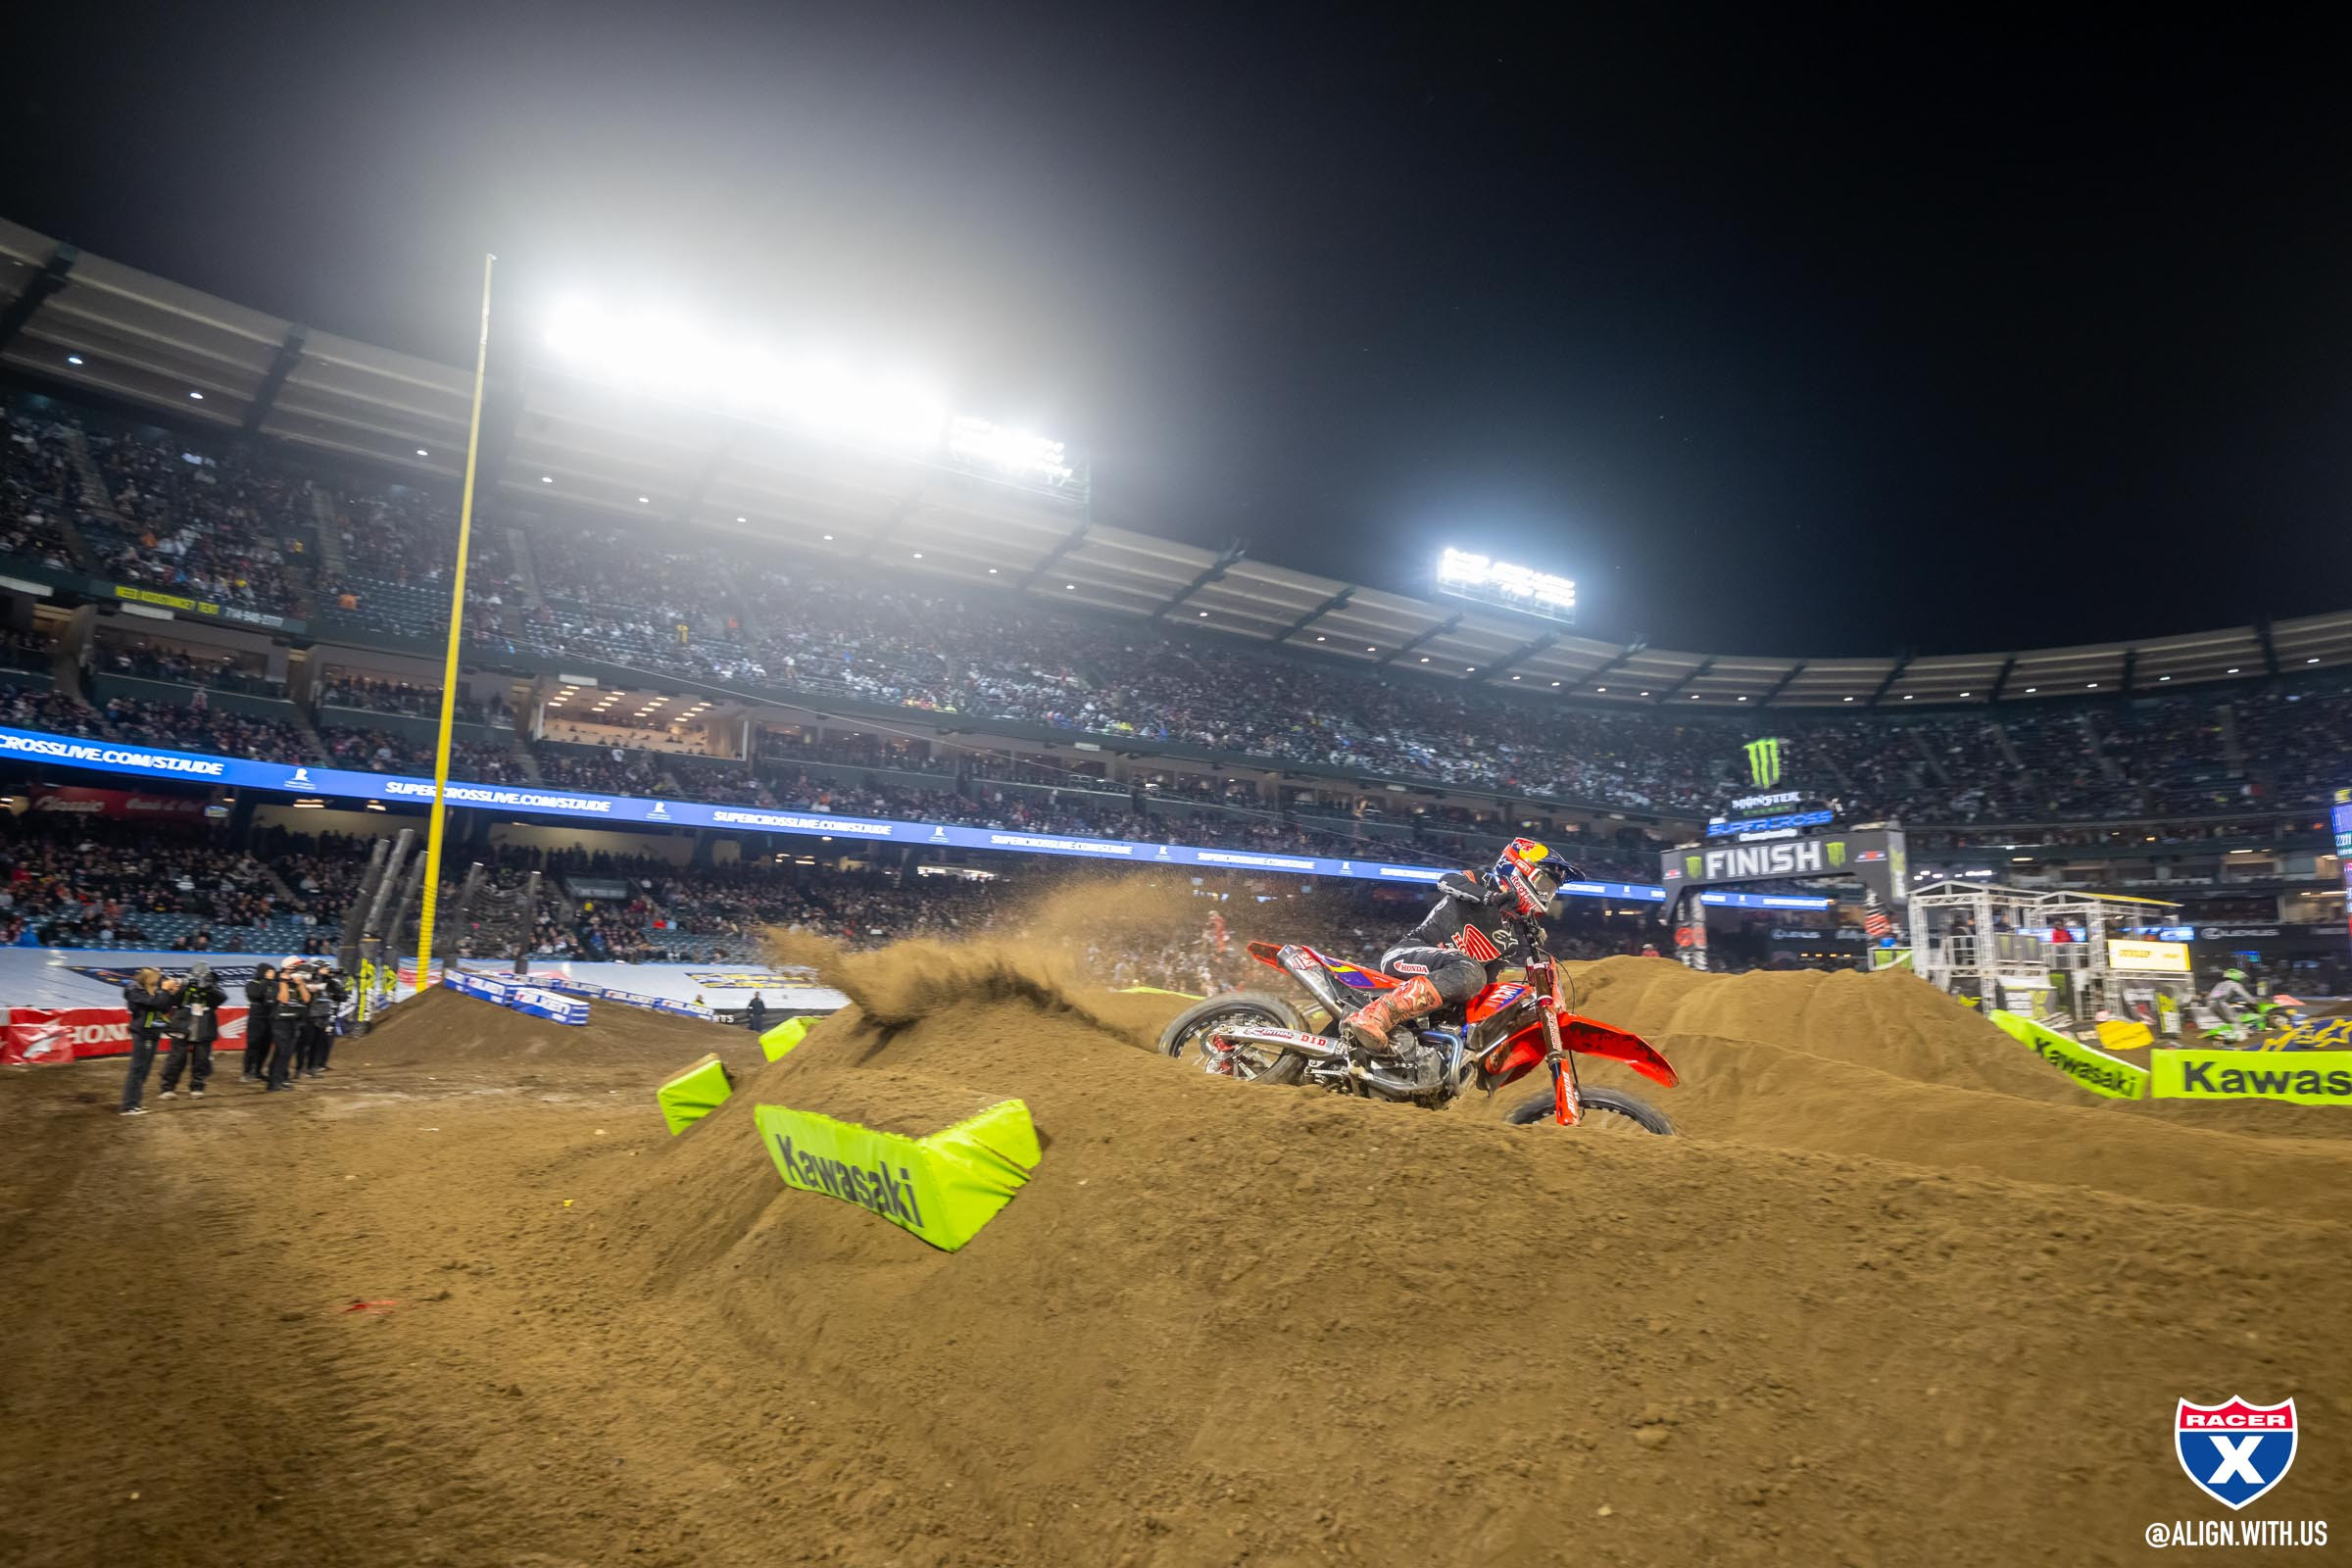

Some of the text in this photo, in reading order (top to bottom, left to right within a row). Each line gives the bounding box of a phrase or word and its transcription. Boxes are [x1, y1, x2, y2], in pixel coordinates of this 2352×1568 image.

[1707, 810, 1834, 837] SUPERCROSS
[1706, 841, 1823, 879] FINISH
[1400, 964, 1428, 974] HONDA
[1300, 1034, 1327, 1047] DID
[2034, 1037, 2136, 1099] Kawasaki
[775, 1133, 925, 1228] Kawasaki
